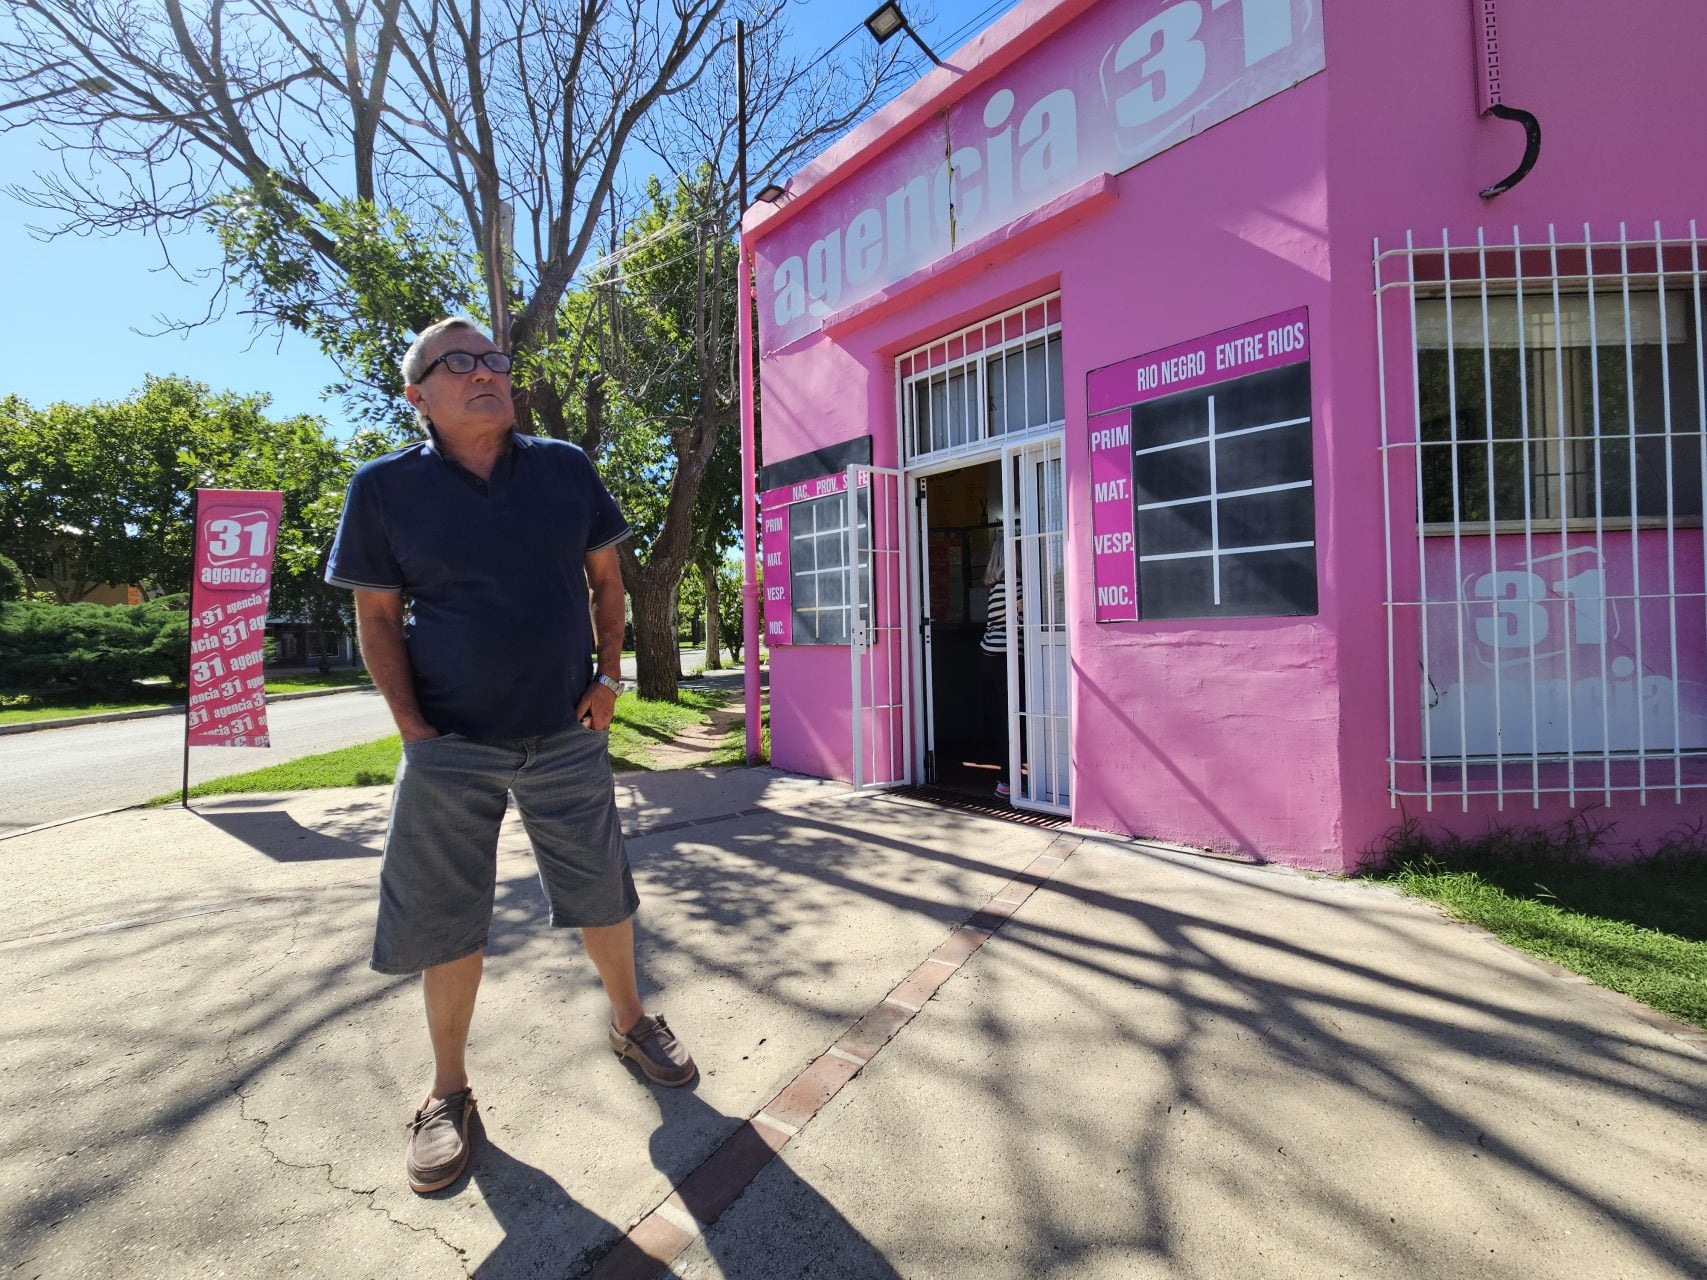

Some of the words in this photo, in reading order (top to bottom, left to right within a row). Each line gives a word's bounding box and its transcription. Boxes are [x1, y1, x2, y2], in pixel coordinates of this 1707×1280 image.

[773, 88, 1078, 327] agencia
[1114, 0, 1293, 128] 31
[1137, 364, 1158, 392] RIO
[1161, 350, 1206, 385] NEGRO
[1215, 333, 1264, 371] ENTRE
[1267, 322, 1304, 357] RIOS
[1091, 424, 1129, 452] PRIM
[792, 484, 810, 501] NAC.
[816, 477, 838, 496] PROV.
[1095, 479, 1129, 504] MAT.
[765, 517, 783, 533] PRIM
[209, 519, 268, 557] 31
[1094, 531, 1134, 555] VESP.
[767, 552, 783, 567] MAT.
[201, 562, 267, 585] agencia
[767, 586, 785, 601] VESP.
[1098, 585, 1133, 607] NOC.
[202, 607, 223, 625] 31
[226, 594, 262, 614] agencia
[1474, 568, 1607, 649] 31
[221, 621, 248, 646] 31
[769, 621, 785, 635] NOC.
[192, 657, 224, 682] 31
[190, 687, 220, 706] encia
[221, 679, 243, 697] 31
[189, 708, 209, 726] 31
[214, 698, 253, 718] agencia
[230, 716, 254, 735] 31
